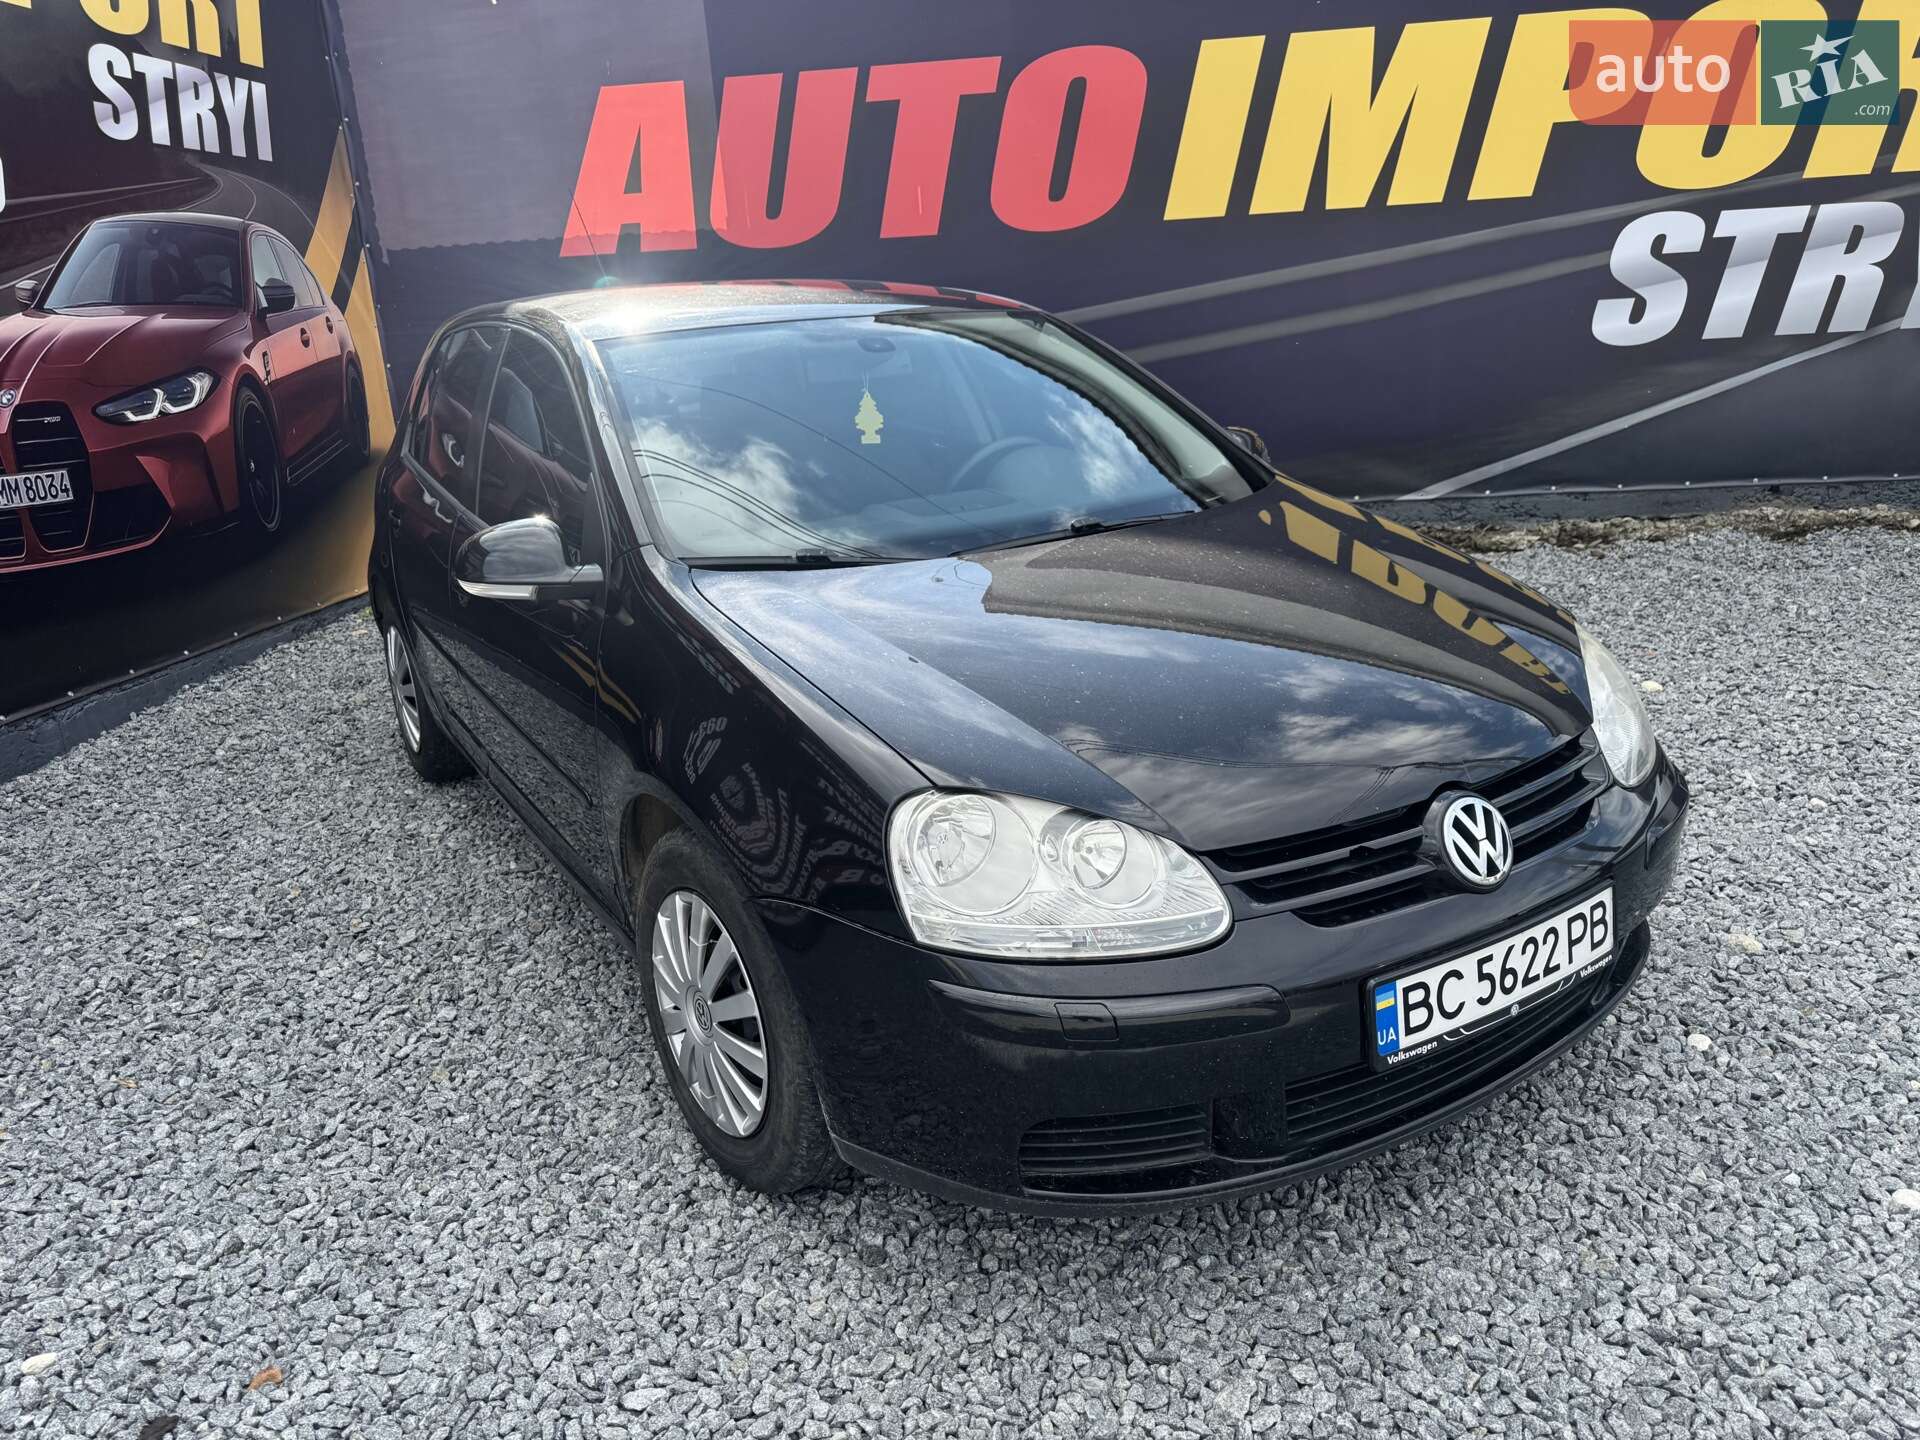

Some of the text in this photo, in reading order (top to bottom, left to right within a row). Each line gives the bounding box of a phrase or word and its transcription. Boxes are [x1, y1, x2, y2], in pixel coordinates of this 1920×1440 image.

[88, 43, 273, 162] STRYI
[560, 45, 1147, 257] AUTO
[1402, 899, 1608, 1037] BC 5622 PB
[1377, 1026, 1397, 1046] UA
[1386, 1041, 1438, 1065] Volkswagen
